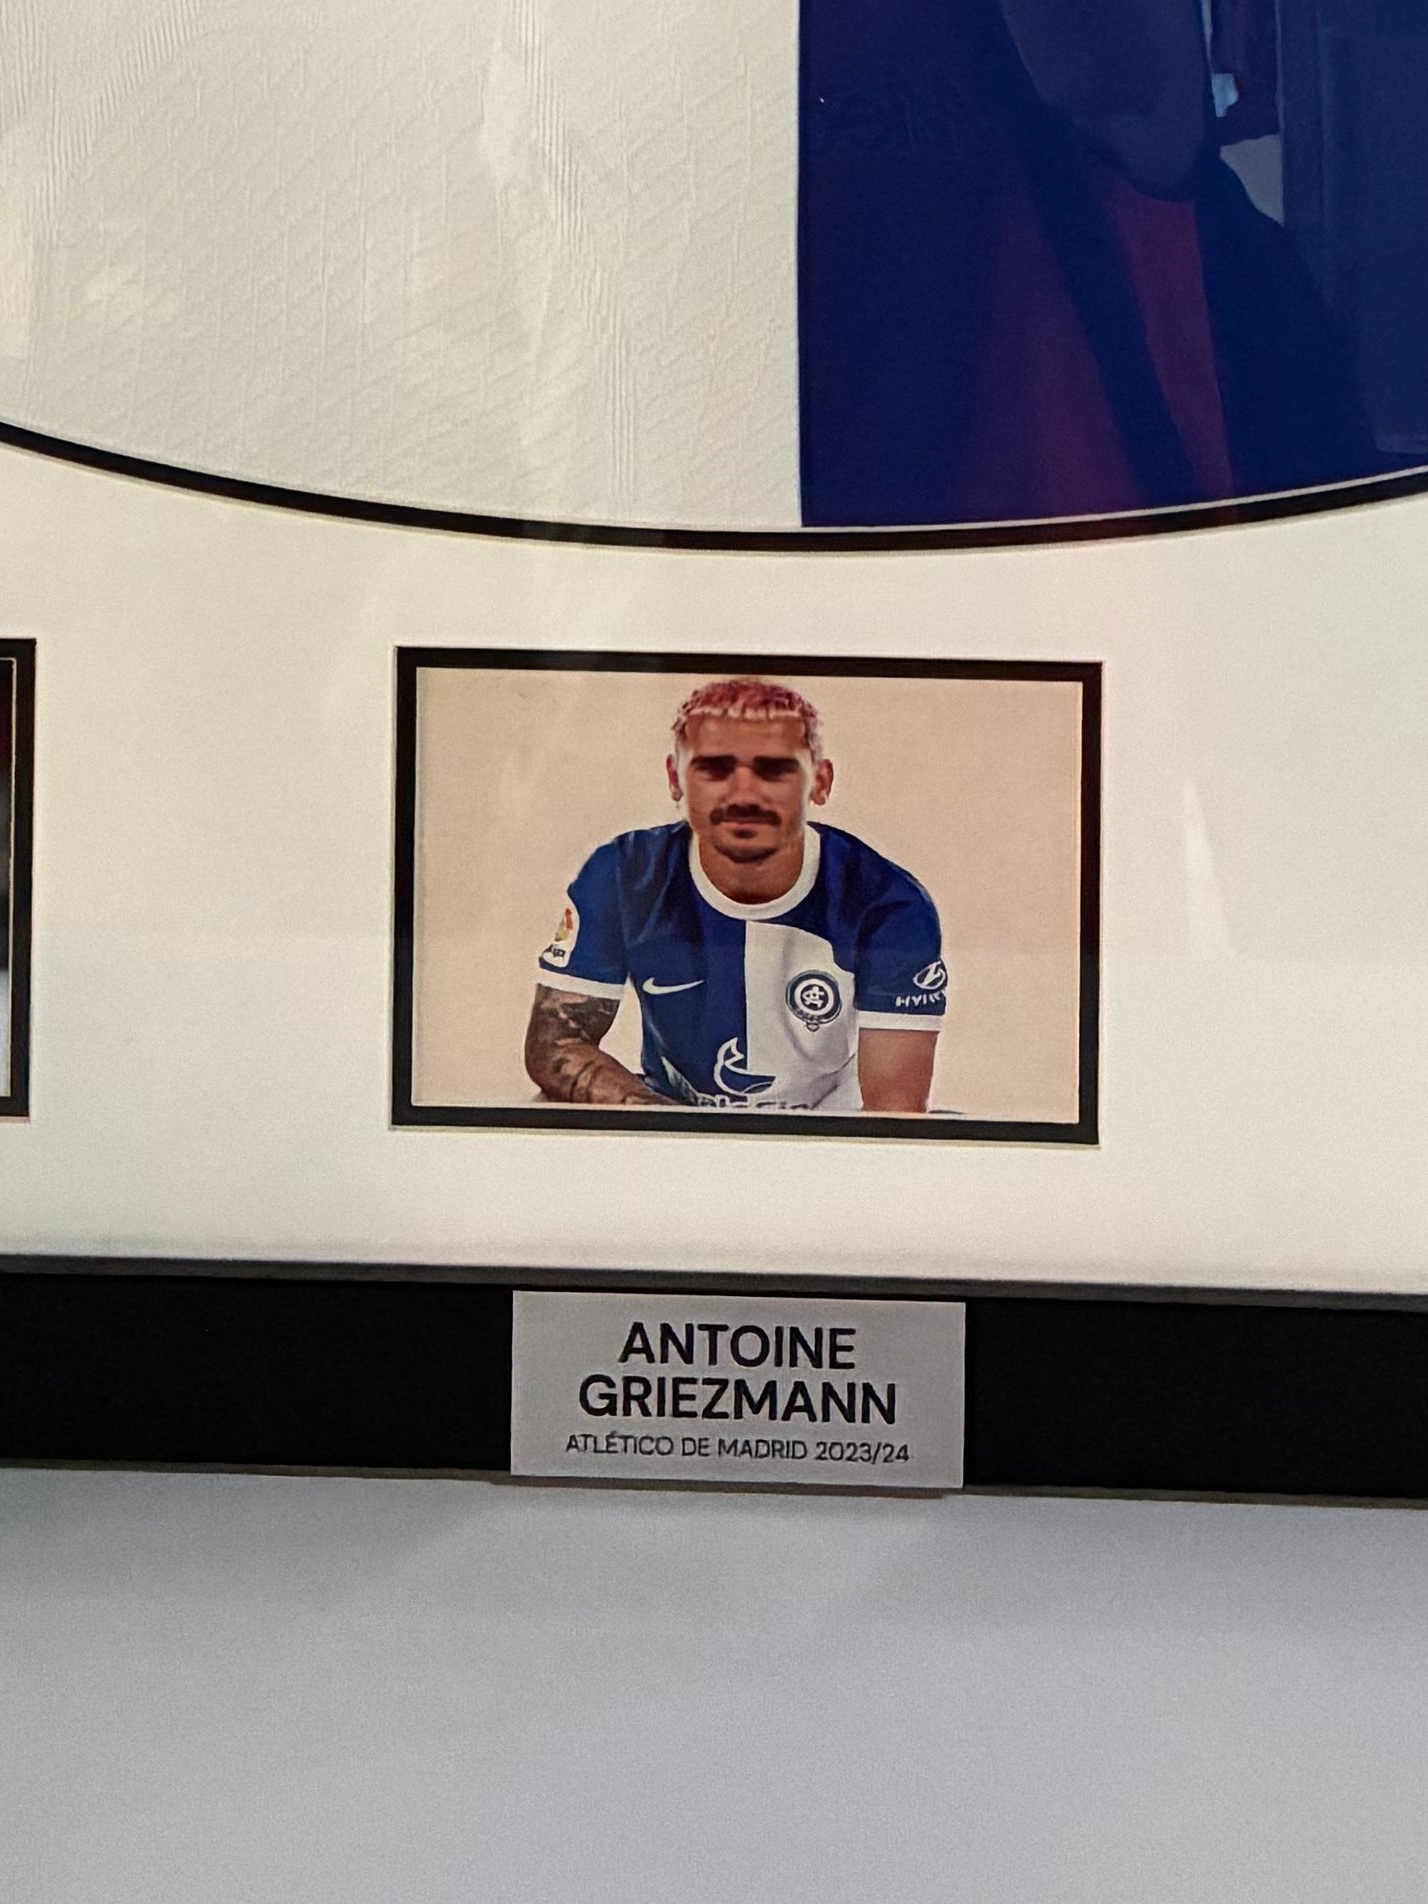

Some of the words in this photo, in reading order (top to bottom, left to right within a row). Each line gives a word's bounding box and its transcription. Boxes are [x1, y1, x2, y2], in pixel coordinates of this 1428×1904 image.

[619, 1321, 857, 1370] ANTOINE
[579, 1374, 897, 1425] GRIEZMANN
[566, 1430, 674, 1456] ATLÉTICO
[681, 1436, 710, 1458] DE
[718, 1439, 808, 1461] MADRID
[815, 1441, 910, 1465] 2023/24
